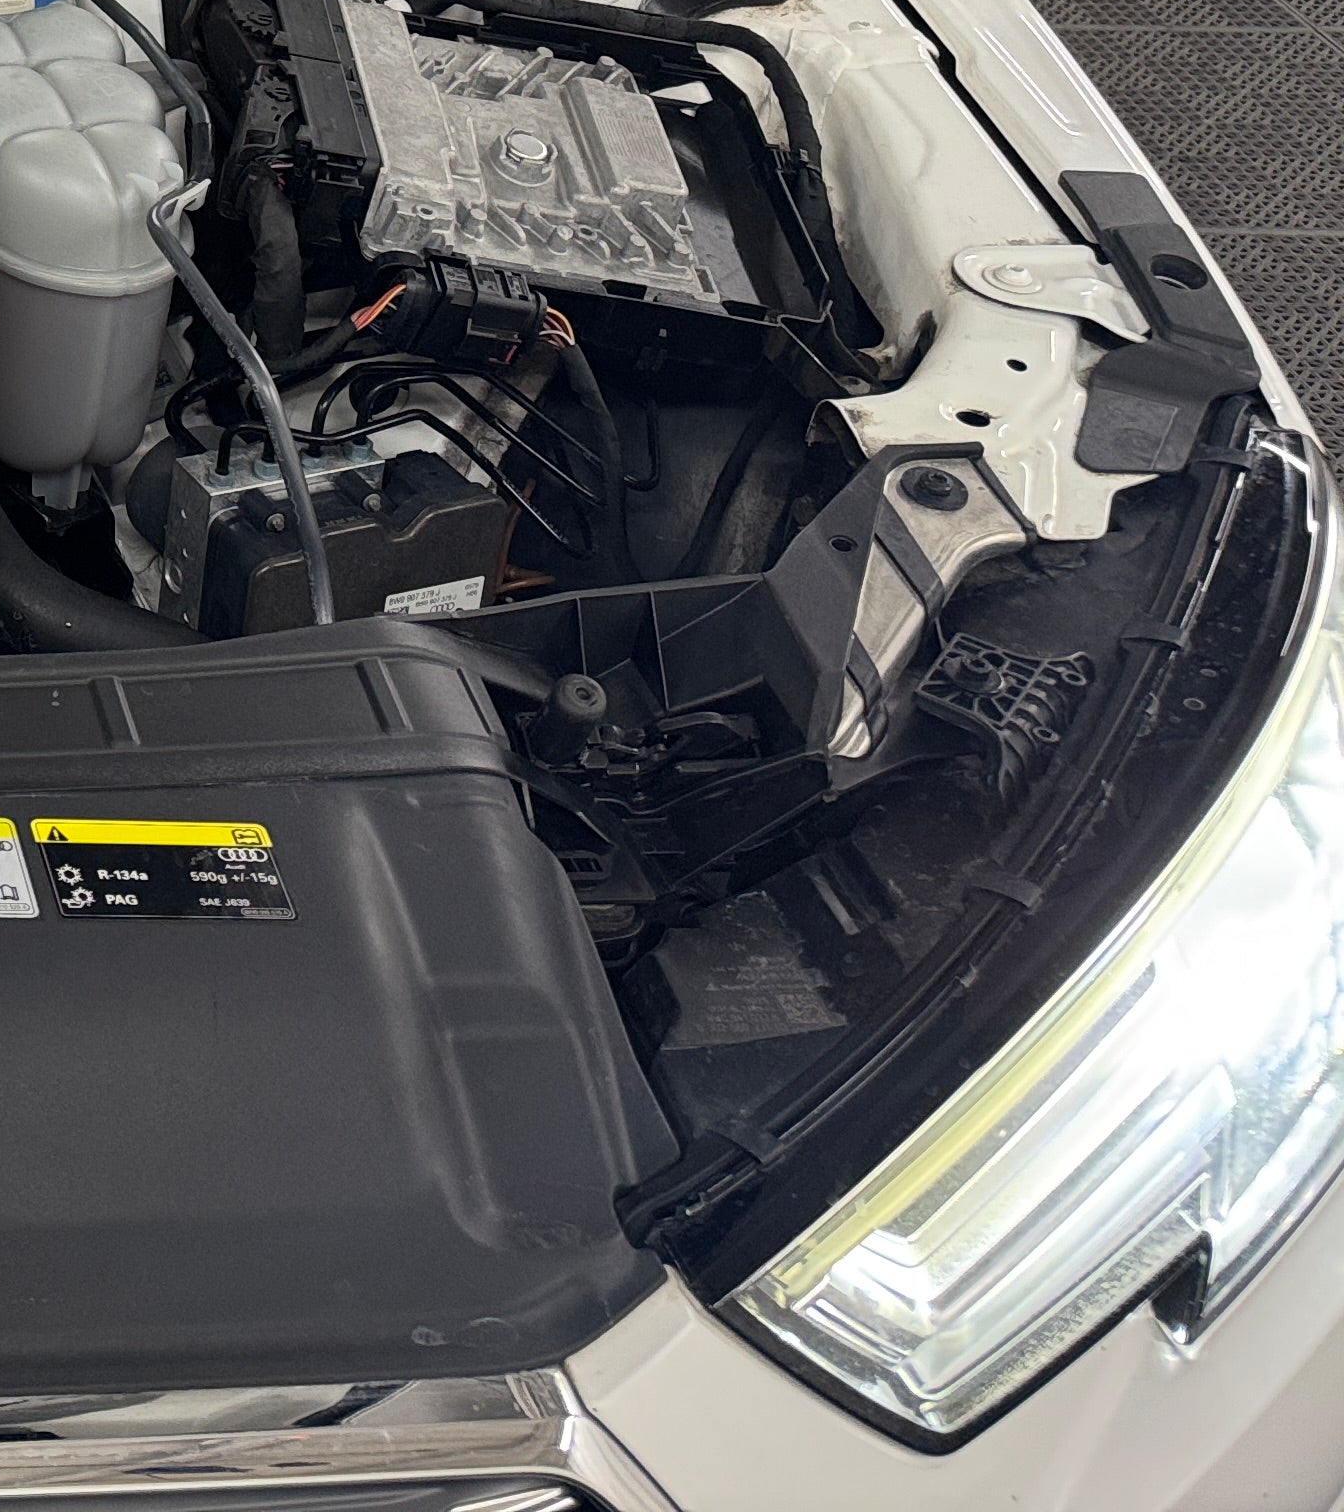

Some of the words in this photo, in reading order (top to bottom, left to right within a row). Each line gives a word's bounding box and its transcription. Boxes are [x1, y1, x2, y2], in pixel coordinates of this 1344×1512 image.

[97, 870, 149, 881] R-134a
[190, 872, 227, 884] 590g
[231, 873, 278, 885] +/-15g
[105, 894, 139, 906] PAG
[199, 898, 222, 907] SAE
